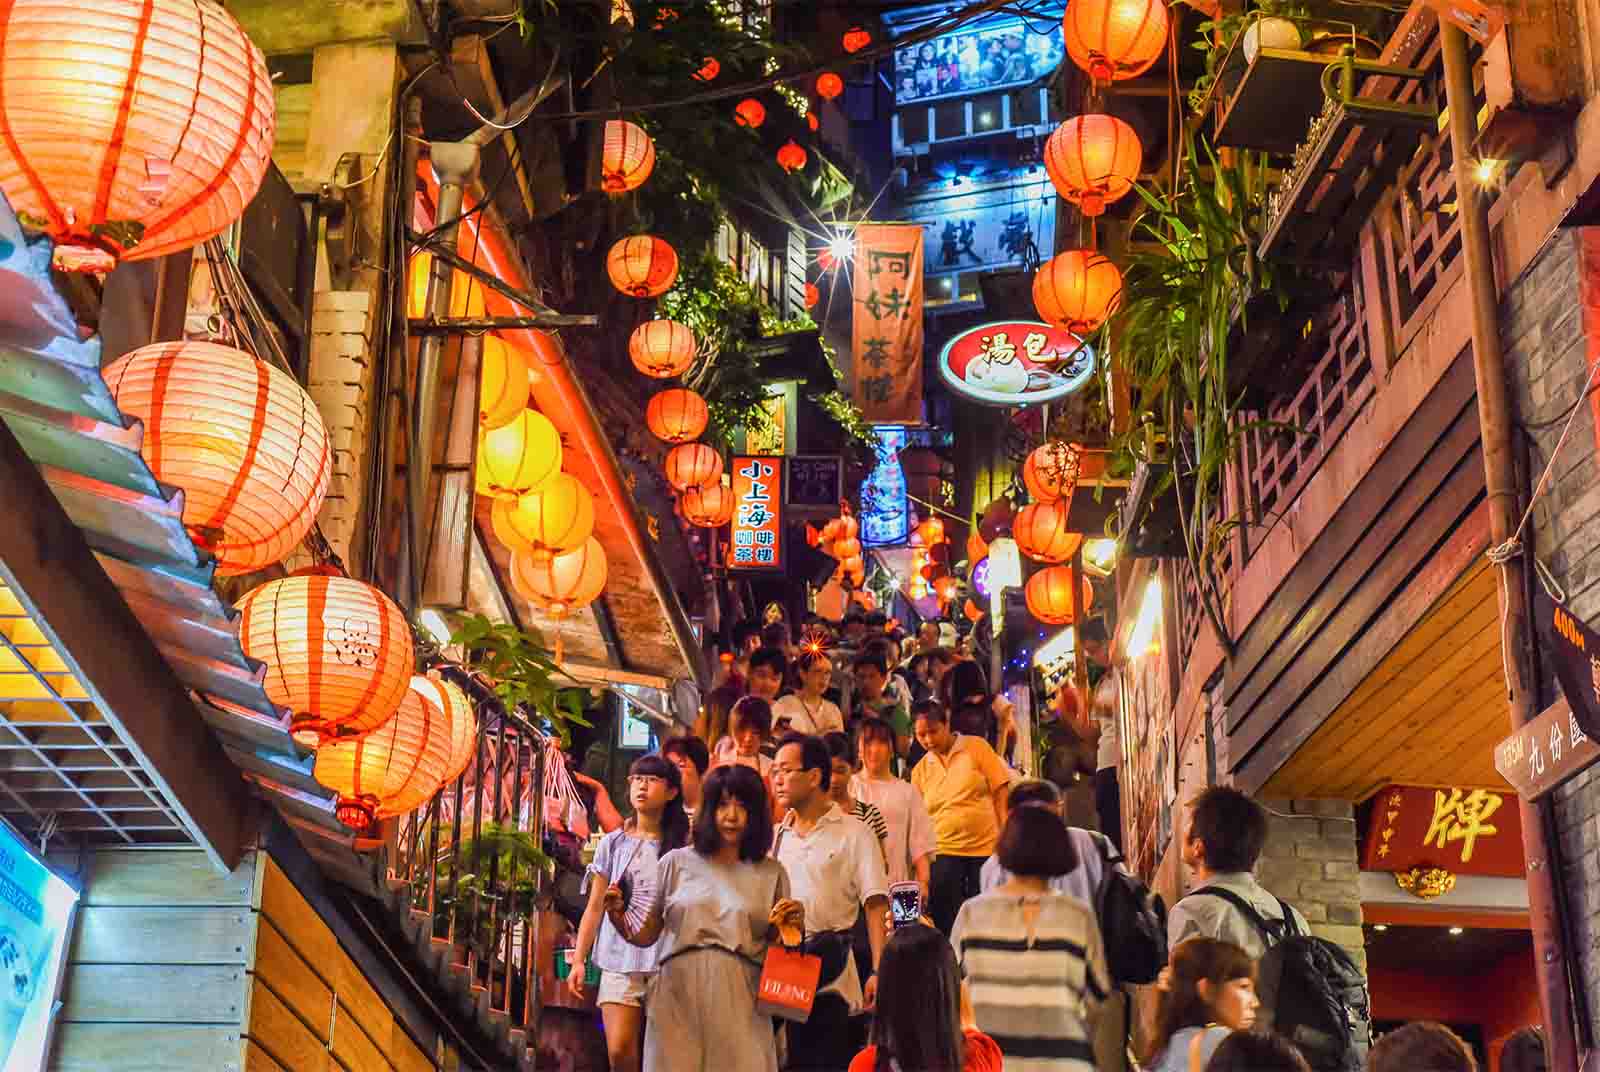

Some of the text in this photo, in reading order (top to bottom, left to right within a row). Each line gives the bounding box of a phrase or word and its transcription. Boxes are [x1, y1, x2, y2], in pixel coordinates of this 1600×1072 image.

[980, 332, 1058, 365] 湯包
[739, 460, 775, 528] 小上海
[1423, 786, 1503, 863] 牌
